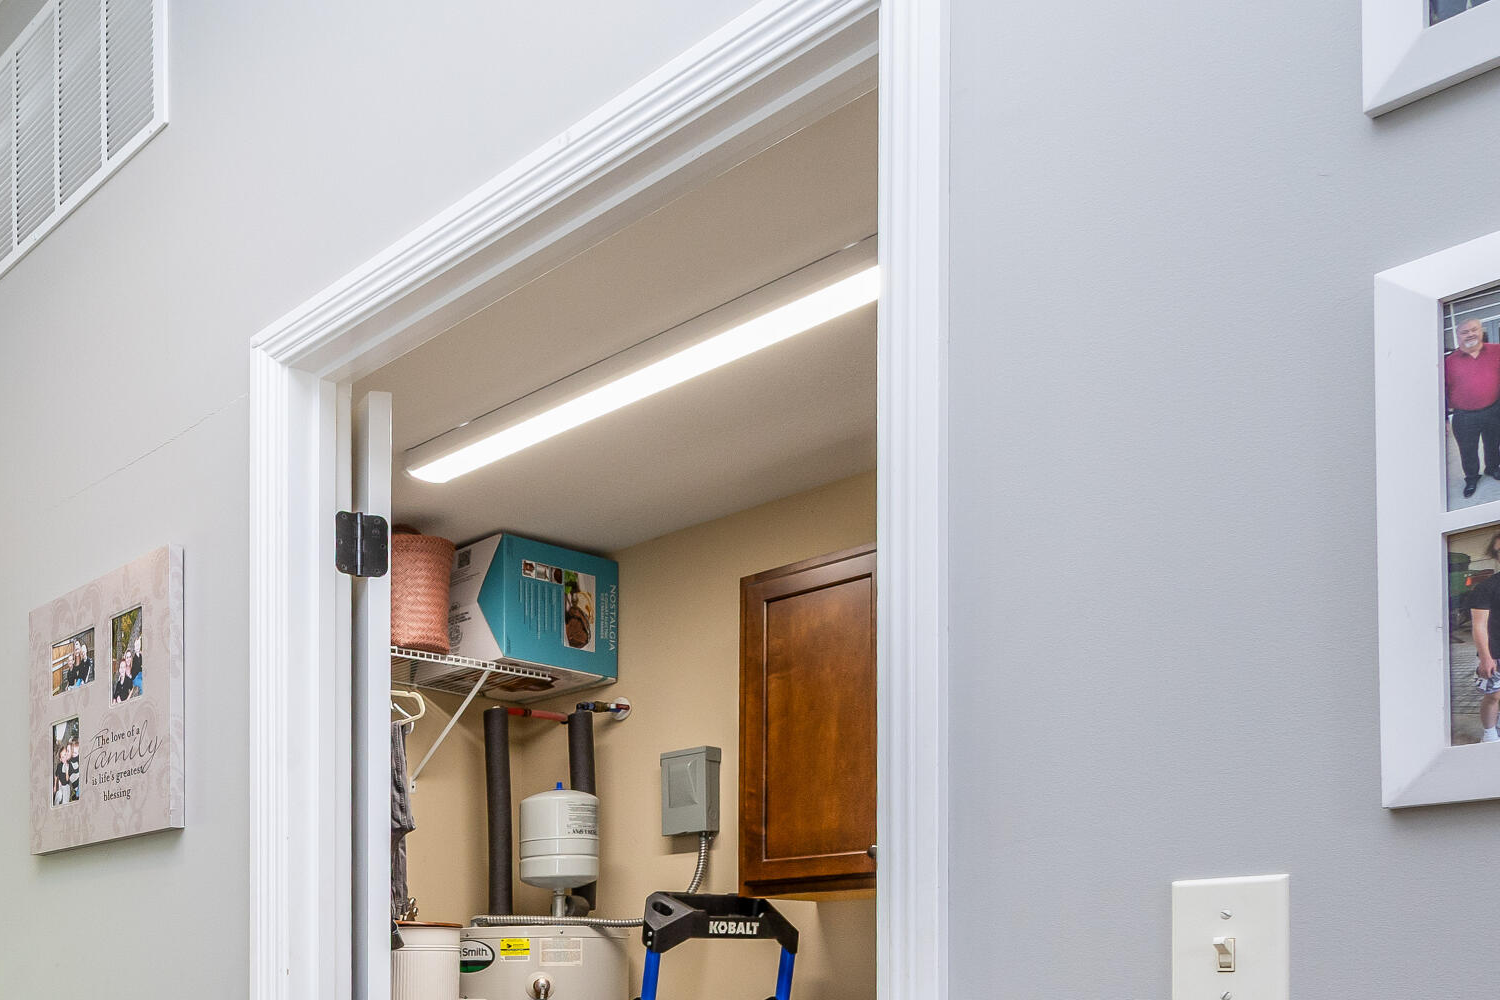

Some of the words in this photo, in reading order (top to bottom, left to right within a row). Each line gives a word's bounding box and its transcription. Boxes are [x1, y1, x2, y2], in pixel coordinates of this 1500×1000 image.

[609, 584, 617, 651] NOSTALGIA
[95, 734, 110, 747] The
[111, 731, 125, 743] love
[127, 725, 135, 737] of
[136, 727, 141, 735] a
[84, 719, 163, 785] Family
[91, 776, 98, 786] is
[98, 770, 115, 784] life's
[115, 765, 144, 784] greatest
[103, 787, 131, 802] blessing
[708, 920, 760, 935] KOBALT
[462, 947, 488, 957] Smith
